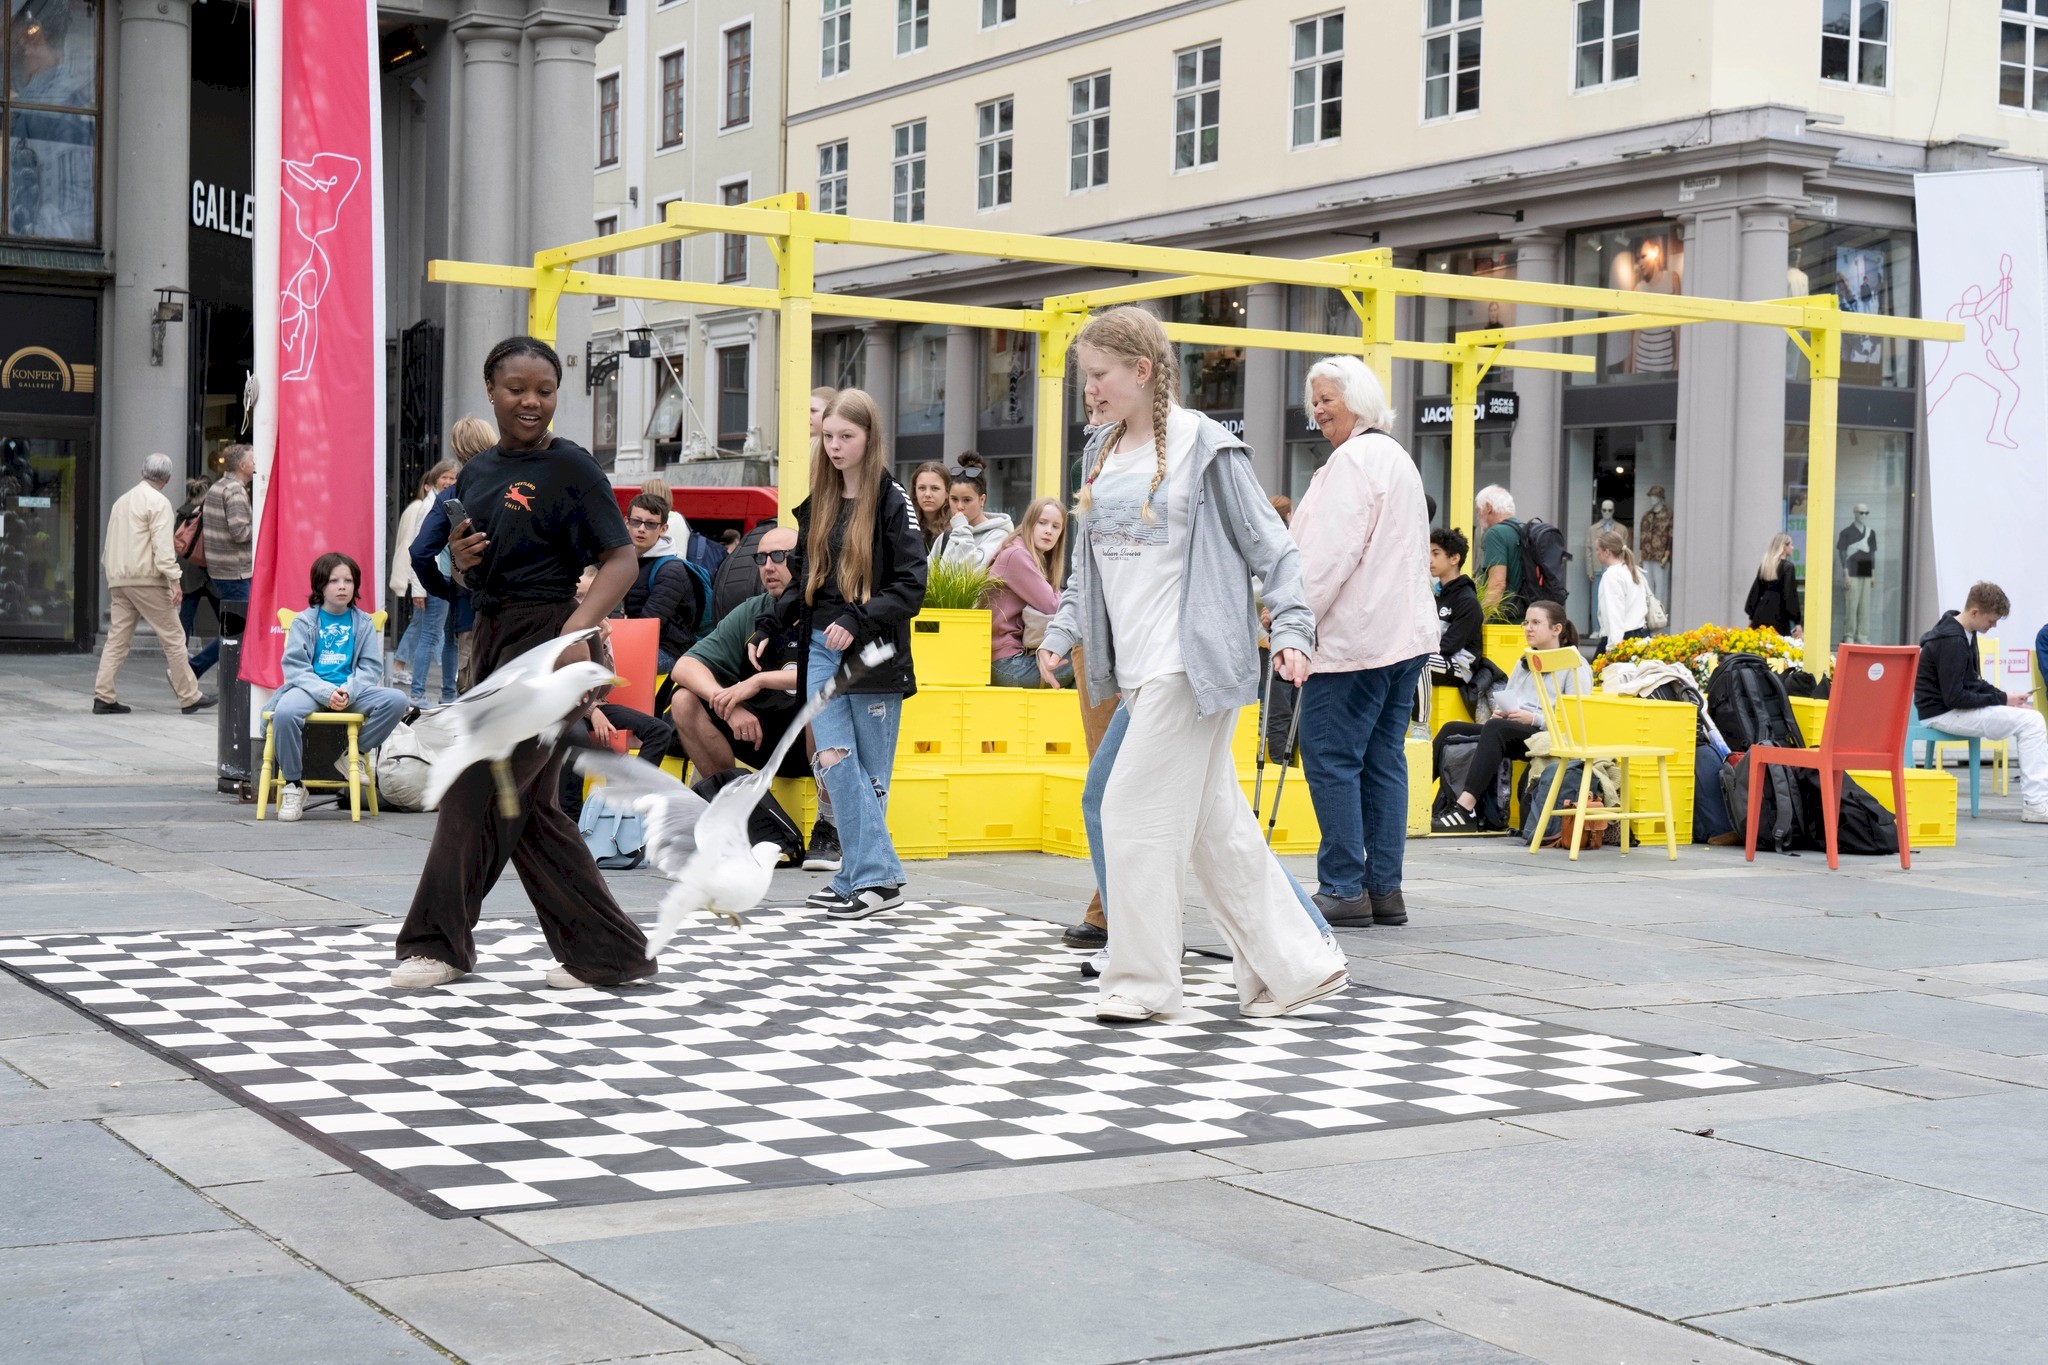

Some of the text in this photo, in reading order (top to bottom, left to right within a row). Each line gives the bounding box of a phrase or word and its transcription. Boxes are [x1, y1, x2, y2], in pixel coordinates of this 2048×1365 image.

[12, 369, 61, 381] KONFEKT
[1489, 397, 1514, 407] JACK&
[1489, 405, 1514, 415] JONES
